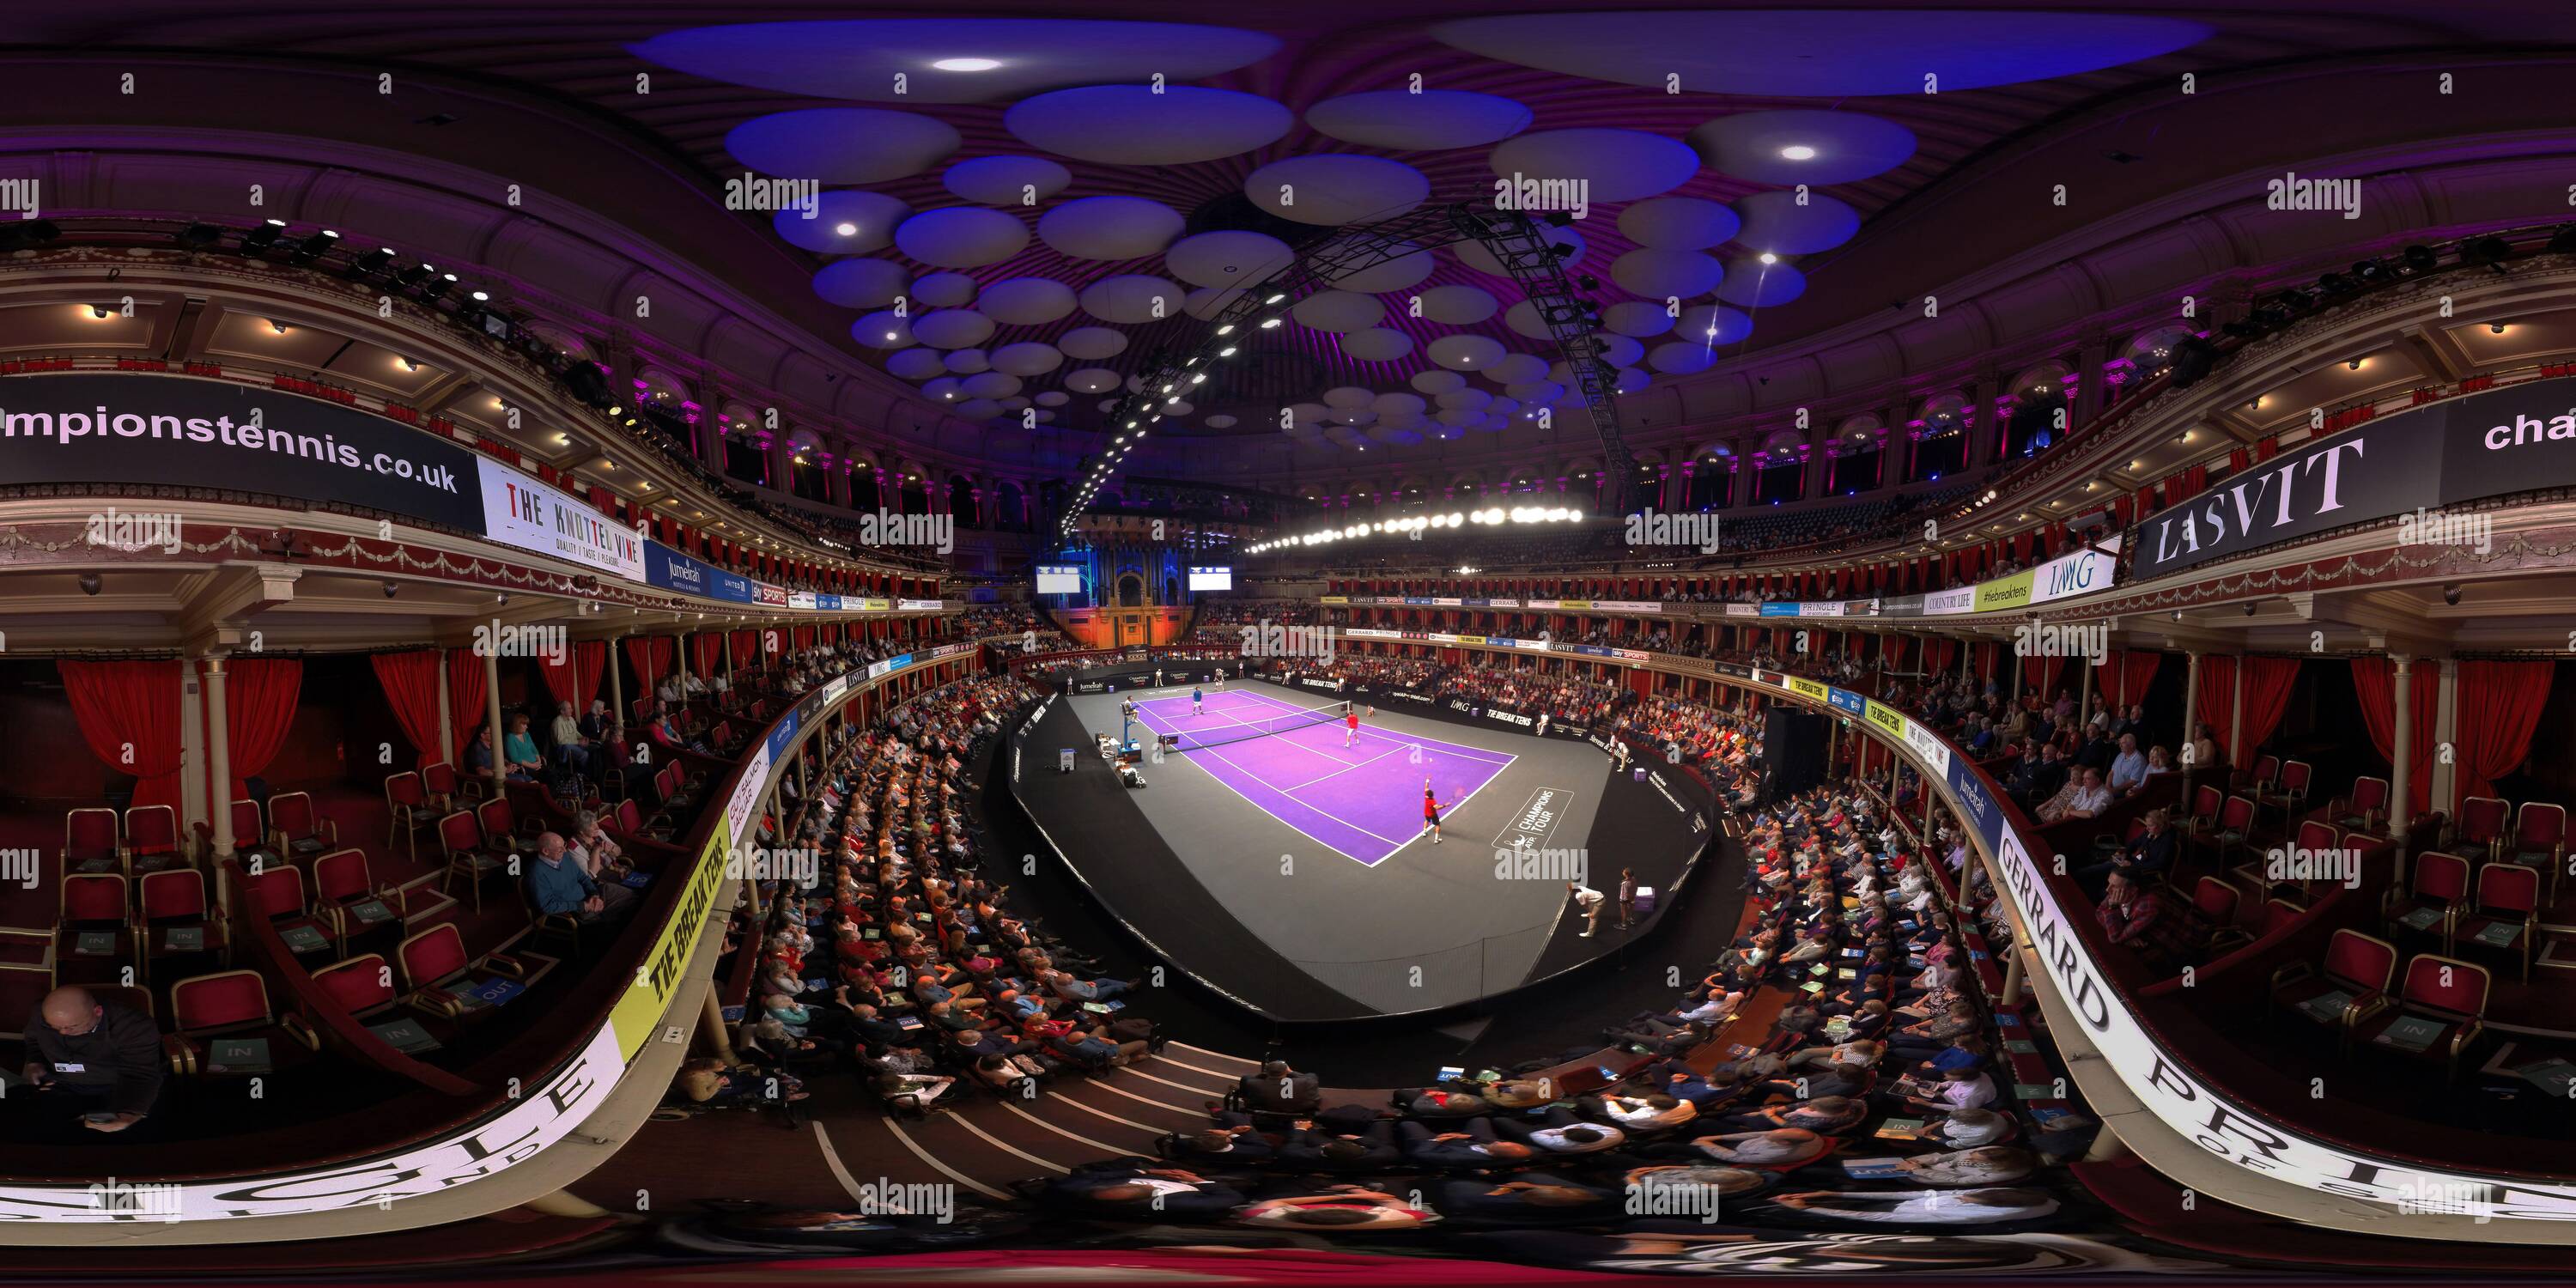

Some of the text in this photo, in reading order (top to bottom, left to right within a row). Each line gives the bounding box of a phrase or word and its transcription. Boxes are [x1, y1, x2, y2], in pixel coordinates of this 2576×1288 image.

[2484, 414, 2576, 450] cha
[2155, 438, 2364, 564] LASVIT
[507, 482, 638, 564] THE KNOTTED VINE
[556, 538, 577, 554] QUALITY
[582, 547, 597, 562] TASTE
[601, 550, 620, 568] PLEASURE
[668, 557, 700, 583] Jumeirah
[2049, 552, 2096, 596] IMG
[724, 579, 741, 589] UNITED
[763, 588, 787, 602] SPORTS
[1929, 593, 1971, 610] COUNTRY LIFE
[1984, 584, 2027, 603] #tiebreaktens
[1802, 603, 1837, 611] PRINGLE
[940, 645, 954, 654] SPORTS
[1551, 643, 1575, 653] LASVIT
[1624, 651, 1648, 660] SPORTS
[1309, 678, 1325, 687] BREAK
[1801, 682, 1814, 695] BREAK
[1814, 685, 1823, 697] TENS
[1450, 699, 1470, 712] IMG
[1486, 708, 1532, 726] TIE BREAK TENS
[1876, 708, 1890, 726] BREAK
[1889, 714, 1900, 732] TENS
[1589, 734, 1605, 748] Stevens
[730, 756, 762, 821] GUY SALMON
[1959, 773, 1985, 818] Jumeirah
[732, 789, 753, 836] JAGUAR
[1518, 790, 1554, 830] CHAMPIONS
[1530, 811, 1554, 832] TOUR
[1524, 836, 1535, 849] ATP
[648, 835, 725, 1005] TIE BREAK TENS
[2002, 837, 2110, 1032] GERRARD
[482, 980, 514, 1000] OUT
[2326, 999, 2349, 1009] IN
[385, 1028, 411, 1041] IN
[2403, 1024, 2427, 1036] IN
[227, 1047, 252, 1058] IN
[2196, 1133, 2276, 1171] OF
